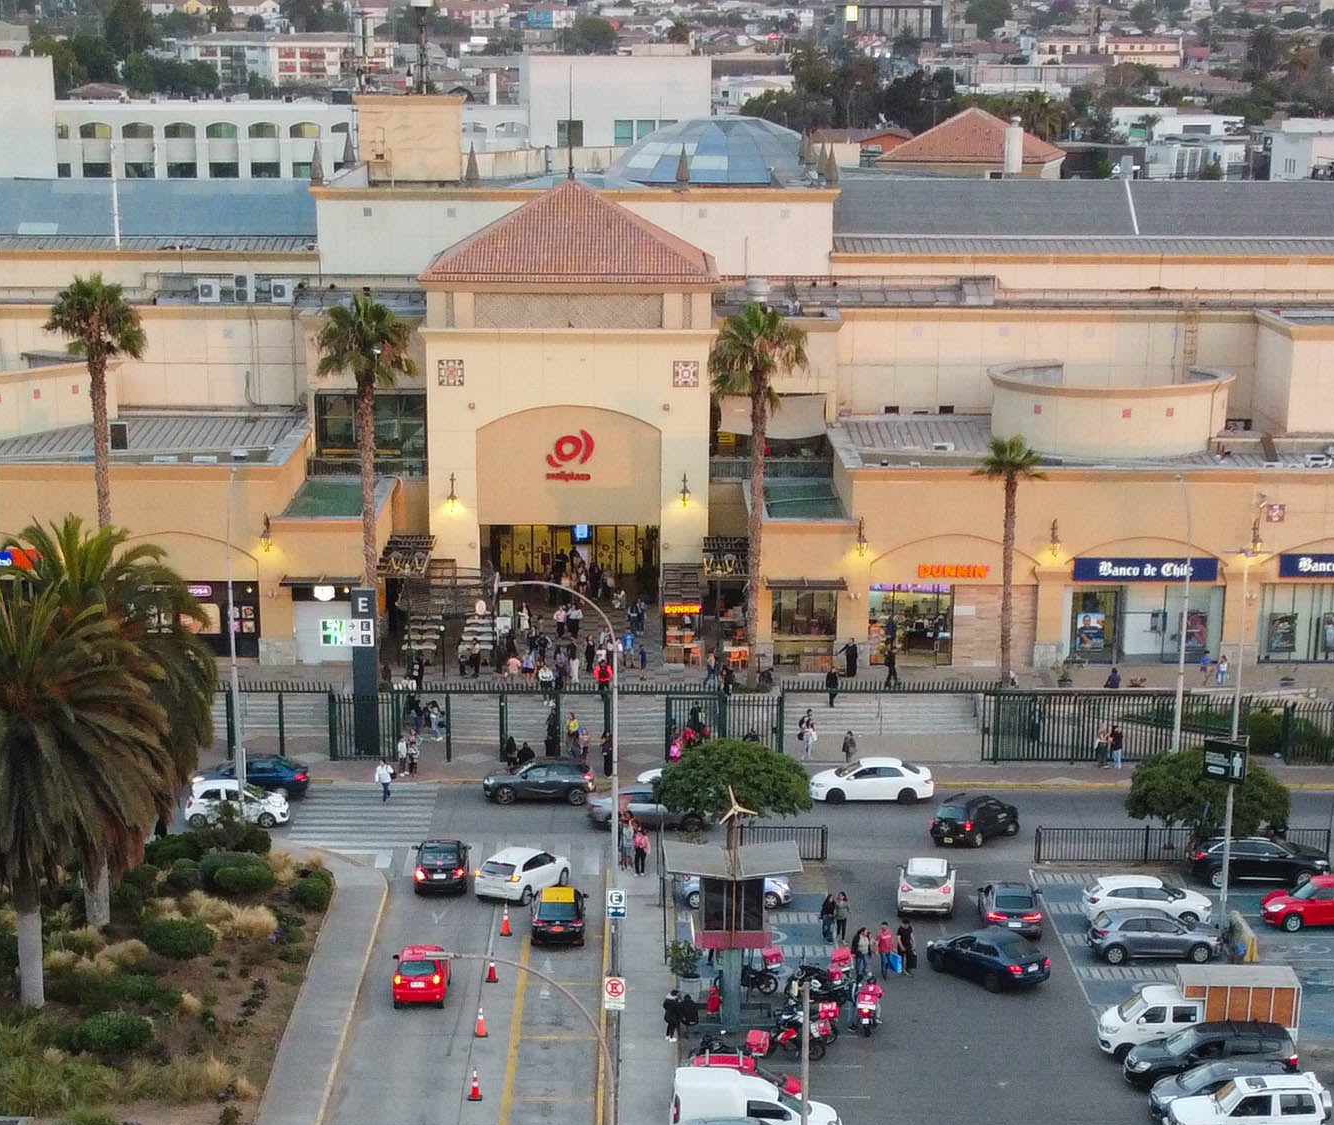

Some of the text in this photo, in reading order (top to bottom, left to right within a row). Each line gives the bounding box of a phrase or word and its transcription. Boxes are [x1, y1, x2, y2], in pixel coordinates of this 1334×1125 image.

[1098, 561, 1195, 578] Banco de Chile
[358, 597, 369, 612] E
